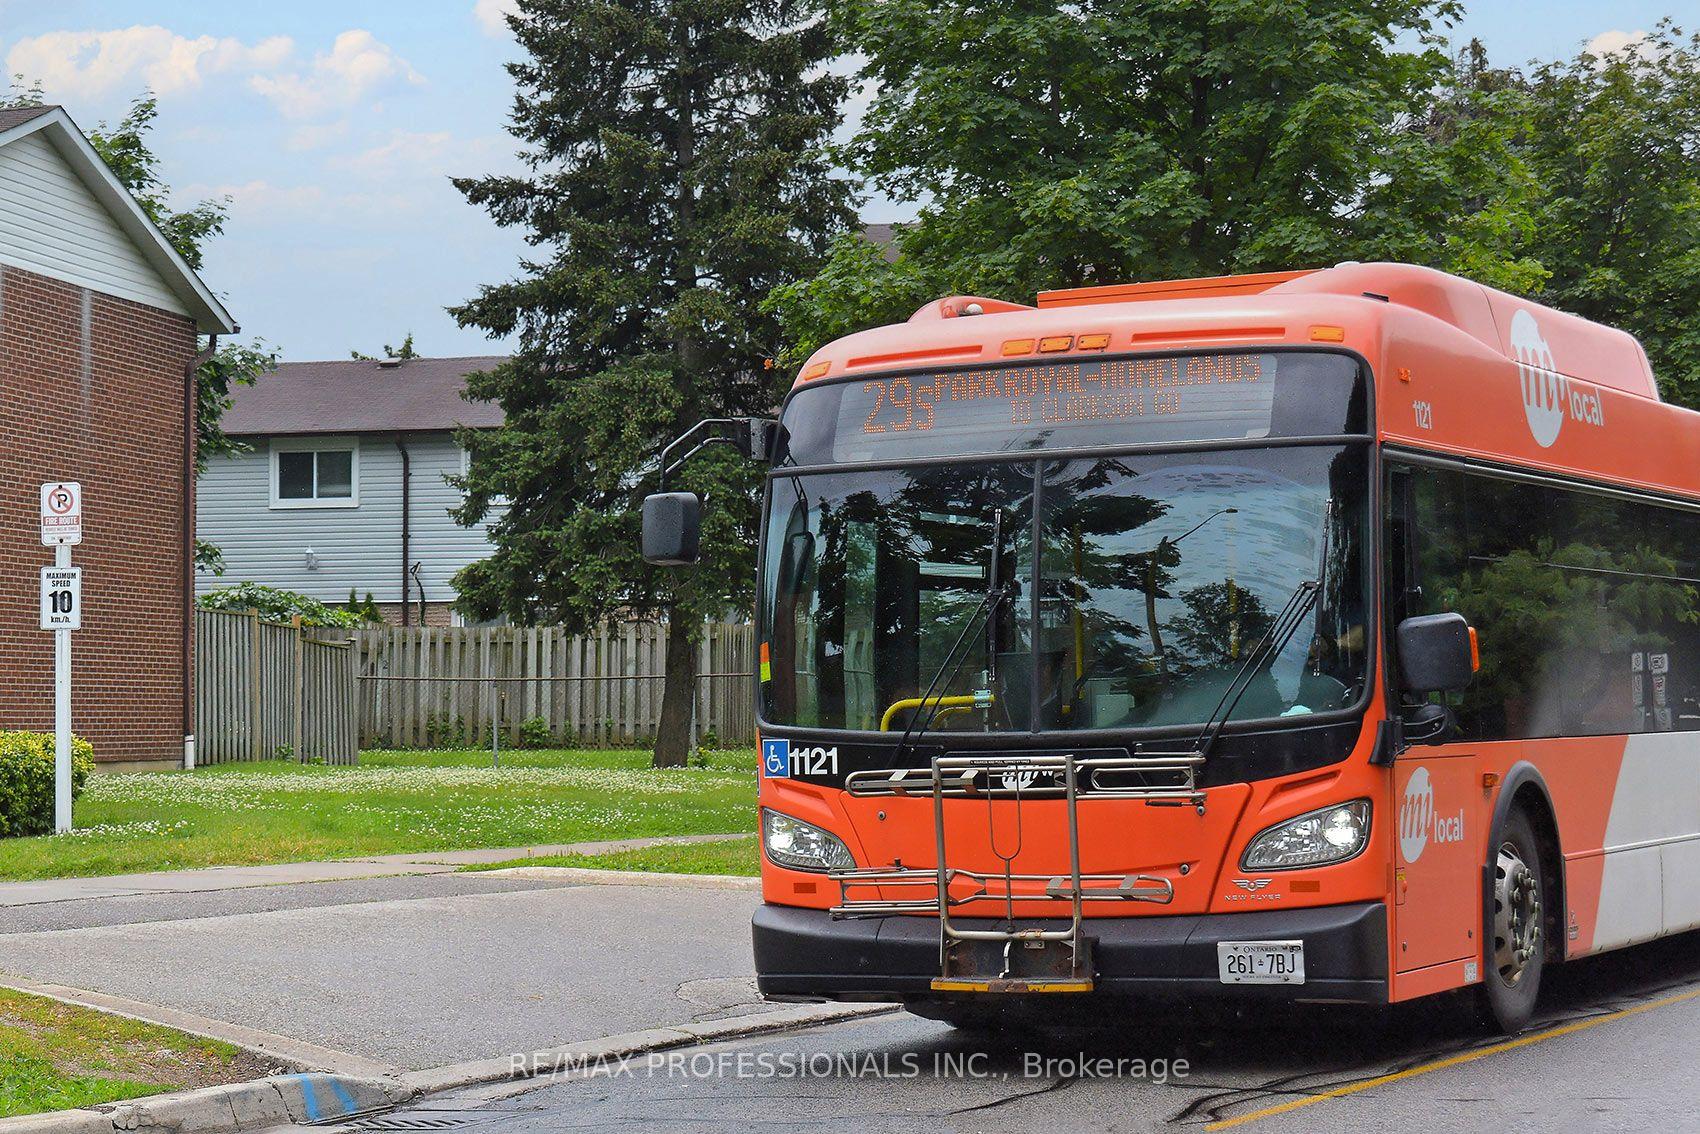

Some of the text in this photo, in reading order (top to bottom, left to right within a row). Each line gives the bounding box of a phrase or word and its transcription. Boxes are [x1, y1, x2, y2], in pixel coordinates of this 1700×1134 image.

[1153, 389, 1183, 415] GO
[1412, 400, 1432, 430] 1121
[1567, 380, 1604, 427] local
[46, 572, 77, 580] MAXIMUM
[51, 580, 71, 588] SPEED
[48, 590, 73, 614] 10
[788, 746, 839, 776] 1121
[1433, 808, 1464, 843] local
[1224, 893, 1247, 901] NEW
